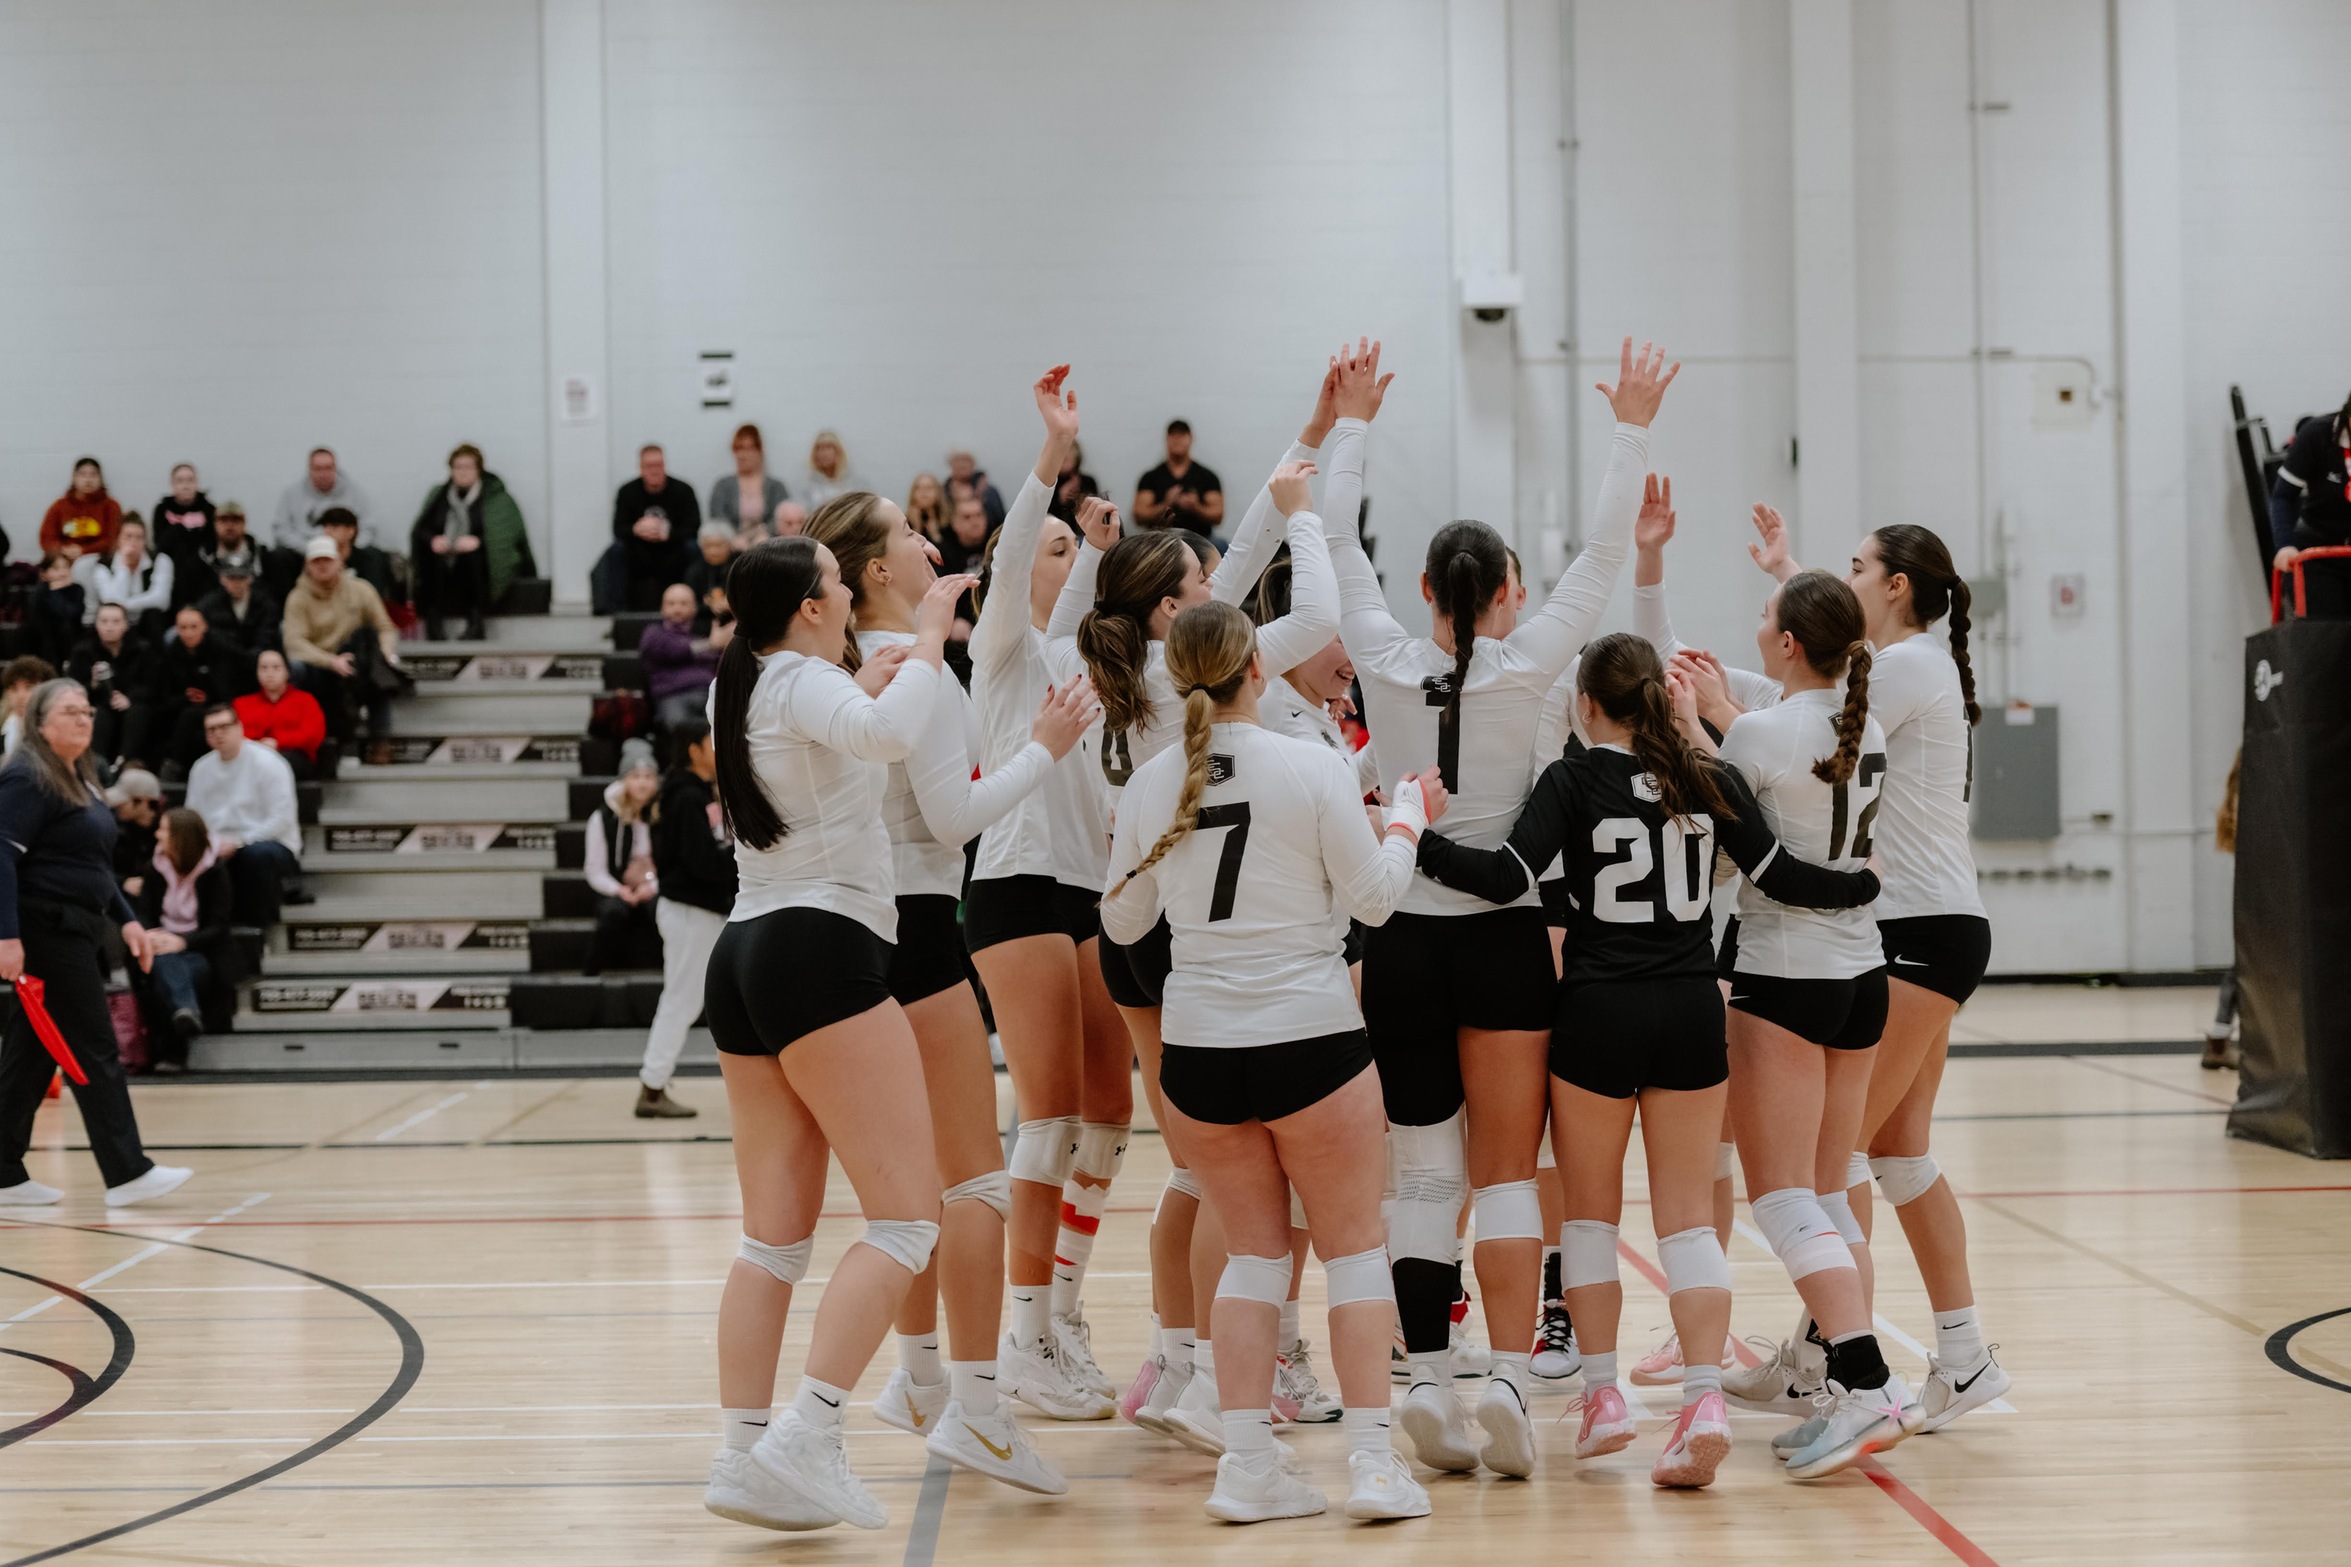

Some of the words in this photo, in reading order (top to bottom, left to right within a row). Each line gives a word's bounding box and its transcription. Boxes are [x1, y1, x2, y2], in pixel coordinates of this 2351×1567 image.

[1195, 801, 1251, 923] 7
[1828, 752, 1888, 862] 12
[1592, 813, 1715, 924] 20
